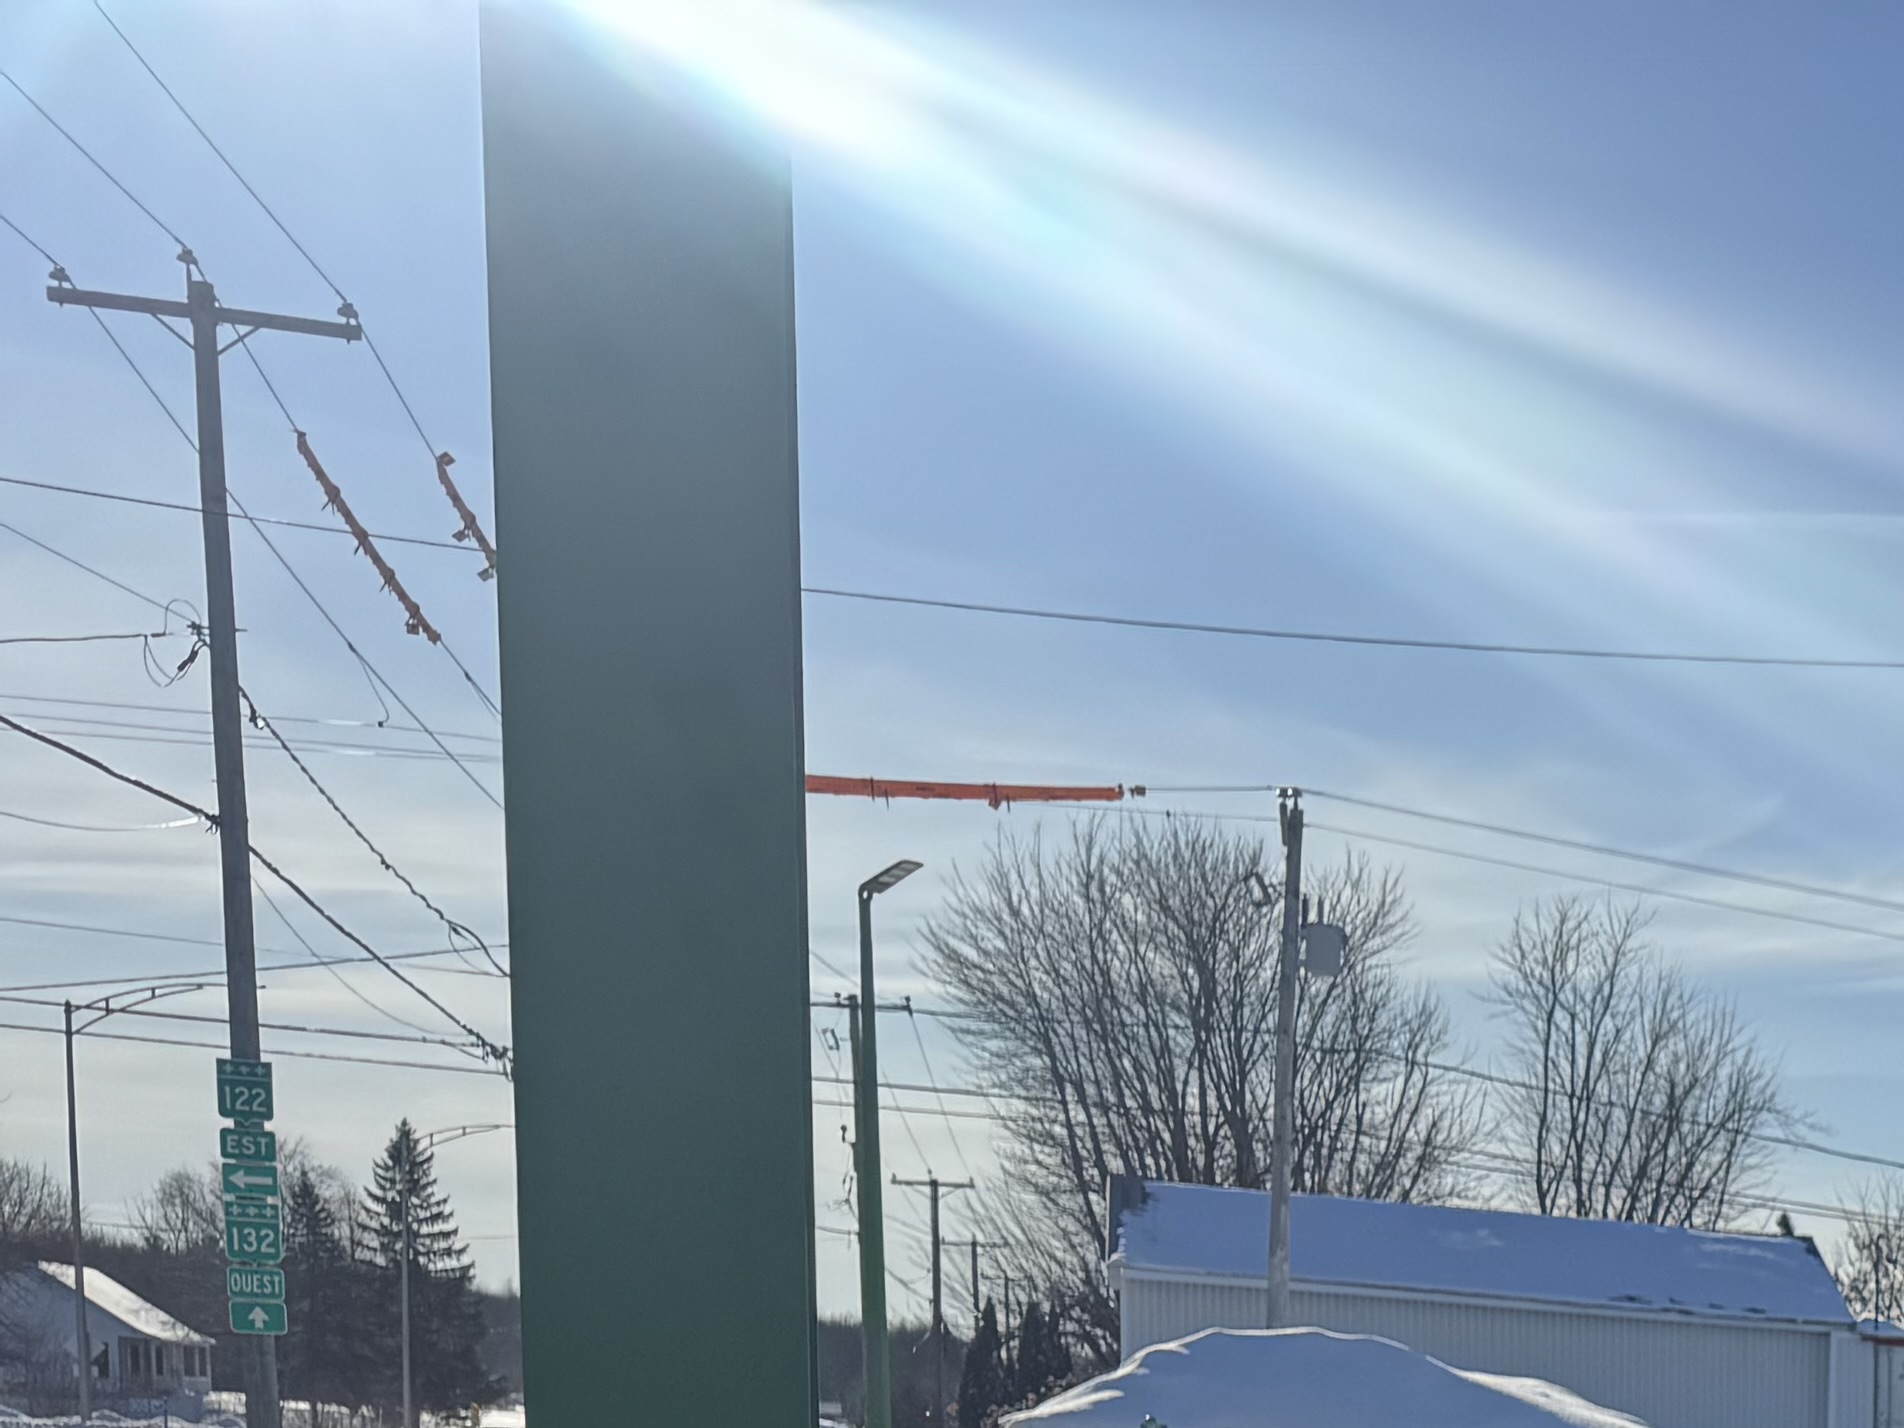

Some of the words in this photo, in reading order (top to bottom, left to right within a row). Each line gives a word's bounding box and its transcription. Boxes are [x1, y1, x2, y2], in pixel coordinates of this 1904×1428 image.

[223, 1085, 267, 1113] 122
[226, 1135, 269, 1157] EST
[232, 1227, 276, 1254] 132
[231, 1274, 280, 1295] OUEST
